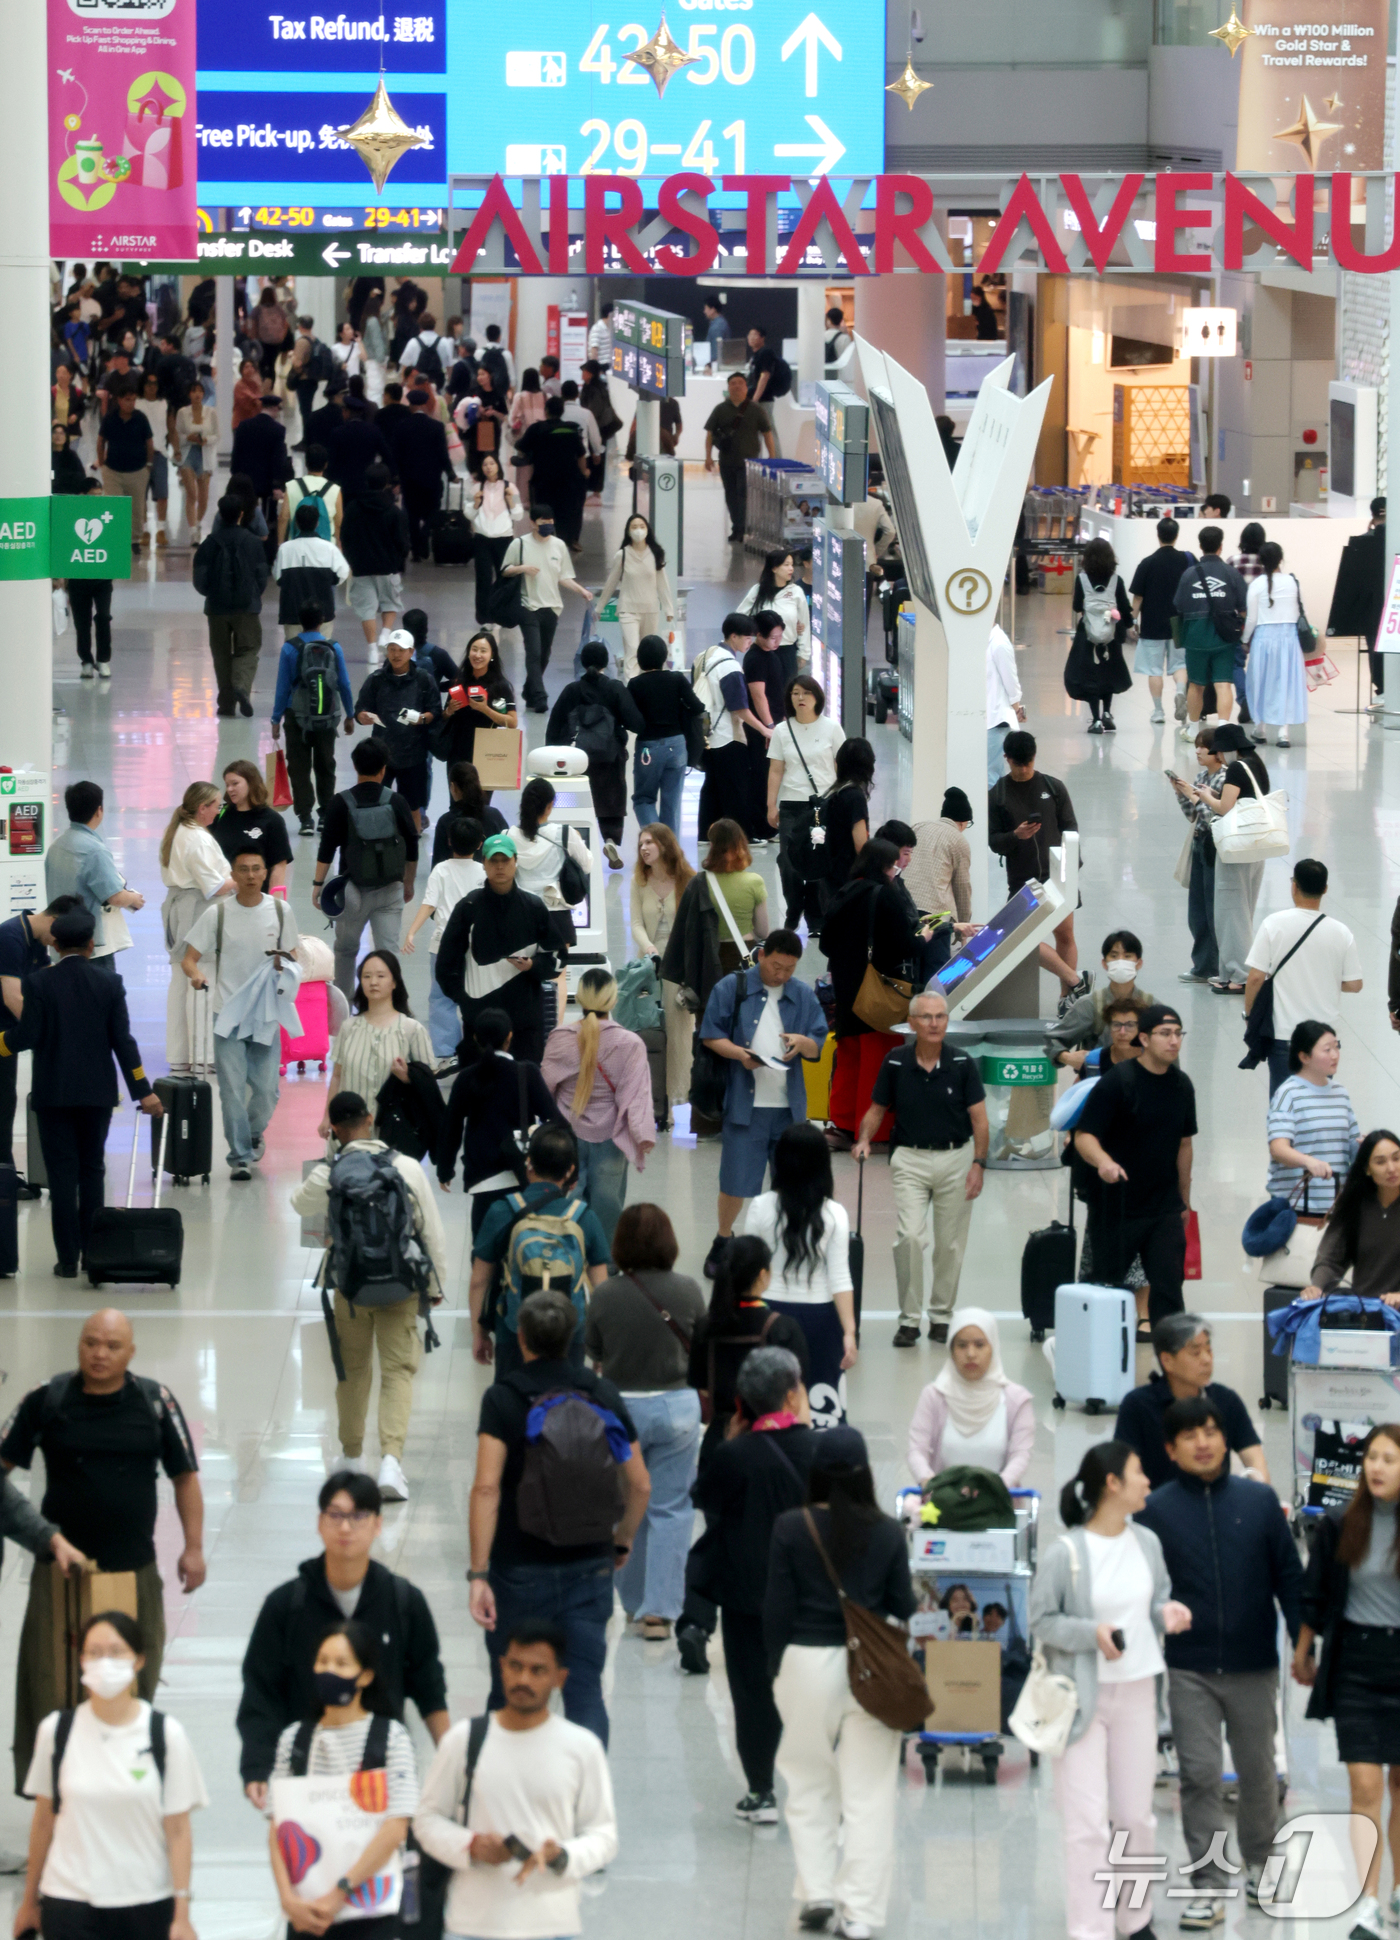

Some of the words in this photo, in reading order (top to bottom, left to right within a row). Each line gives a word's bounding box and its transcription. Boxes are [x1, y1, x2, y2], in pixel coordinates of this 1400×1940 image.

[83, 26, 102, 35] Scan
[102, 27, 112, 35] to
[112, 27, 134, 35] Order
[268, 15, 306, 40] Tax
[310, 14, 390, 43] Refund,
[393, 16, 436, 43] 退税
[1253, 24, 1280, 36] Win
[1281, 26, 1292, 36] a
[1331, 24, 1375, 36] Million
[66, 34, 82, 44] Pick
[82, 35, 94, 45] Up
[112, 36, 147, 46] Shopping
[147, 37, 153, 45] &
[1275, 39, 1308, 52] Gold
[1309, 39, 1339, 52] Star
[1341, 39, 1352, 52] &
[98, 45, 108, 53] All
[116, 46, 131, 54] One
[131, 46, 148, 55] App
[579, 23, 756, 86] 4250
[1261, 54, 1303, 67] Travel
[1305, 54, 1368, 67] Rewards!
[237, 122, 316, 154] Pick-up,
[579, 118, 746, 176] 29-41
[254, 206, 315, 227] 42-50
[364, 207, 421, 228] 29-41
[449, 171, 945, 277] AIRSTAR
[110, 234, 158, 247] AIRSTAR
[196, 237, 246, 258] nsfer
[248, 238, 295, 258] Desk
[356, 242, 430, 265] Transfer
[0, 521, 36, 540] AED
[70, 548, 108, 563] AED
[1192, 591, 1227, 599] UMRO
[14, 804, 39, 817] AED
[1021, 1073, 1044, 1081] Recycle
